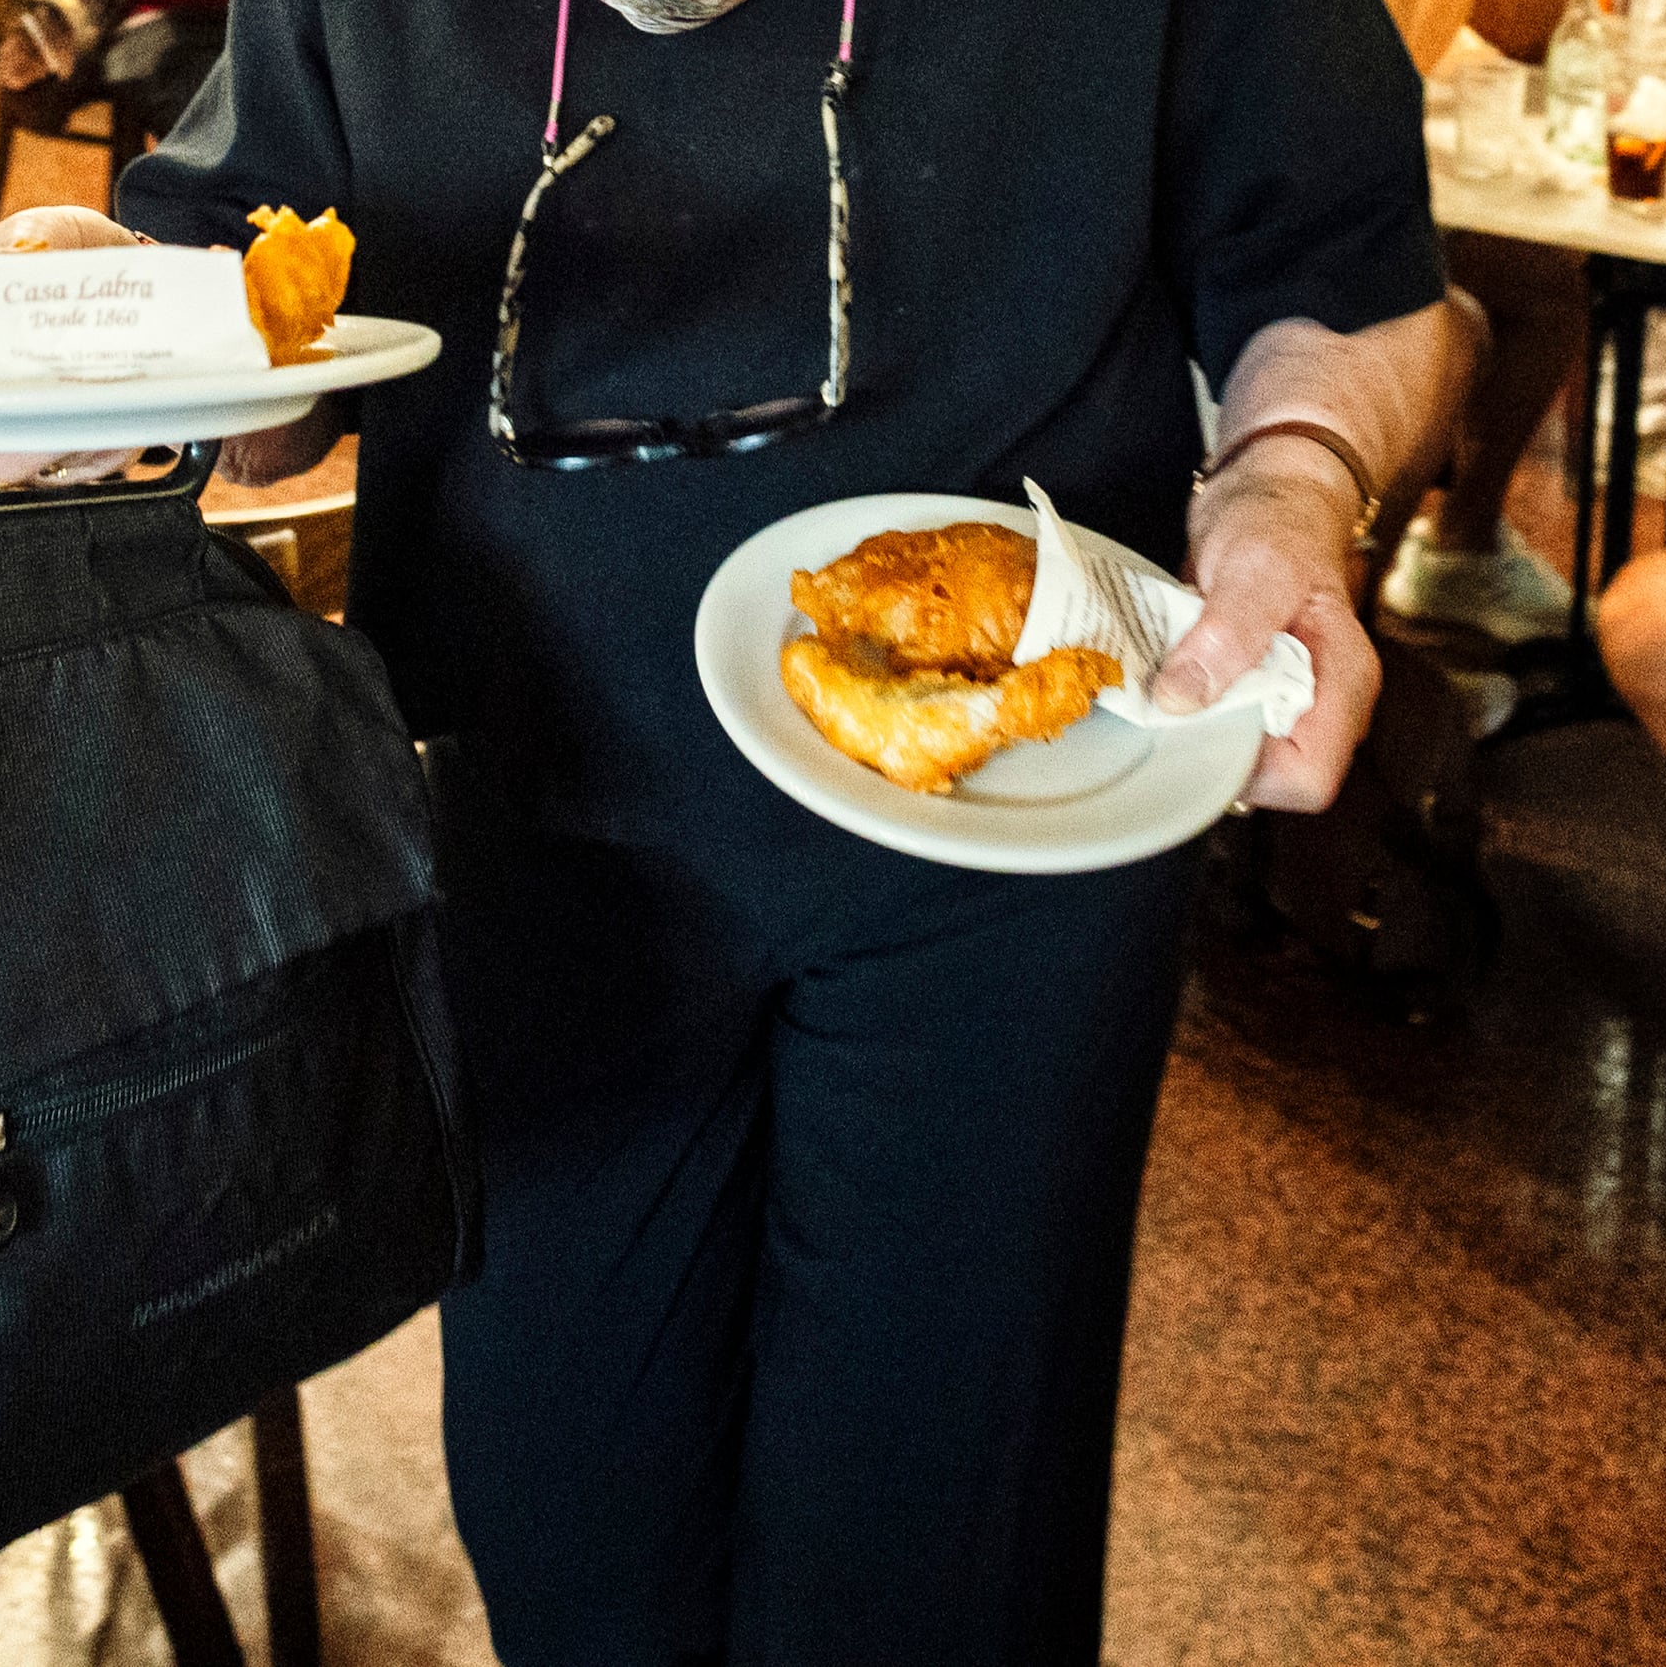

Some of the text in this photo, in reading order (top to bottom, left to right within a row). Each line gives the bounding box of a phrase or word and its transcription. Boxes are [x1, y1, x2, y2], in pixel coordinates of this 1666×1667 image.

[3, 269, 155, 304] Casa Labra
[29, 306, 140, 329] Desde 1860
